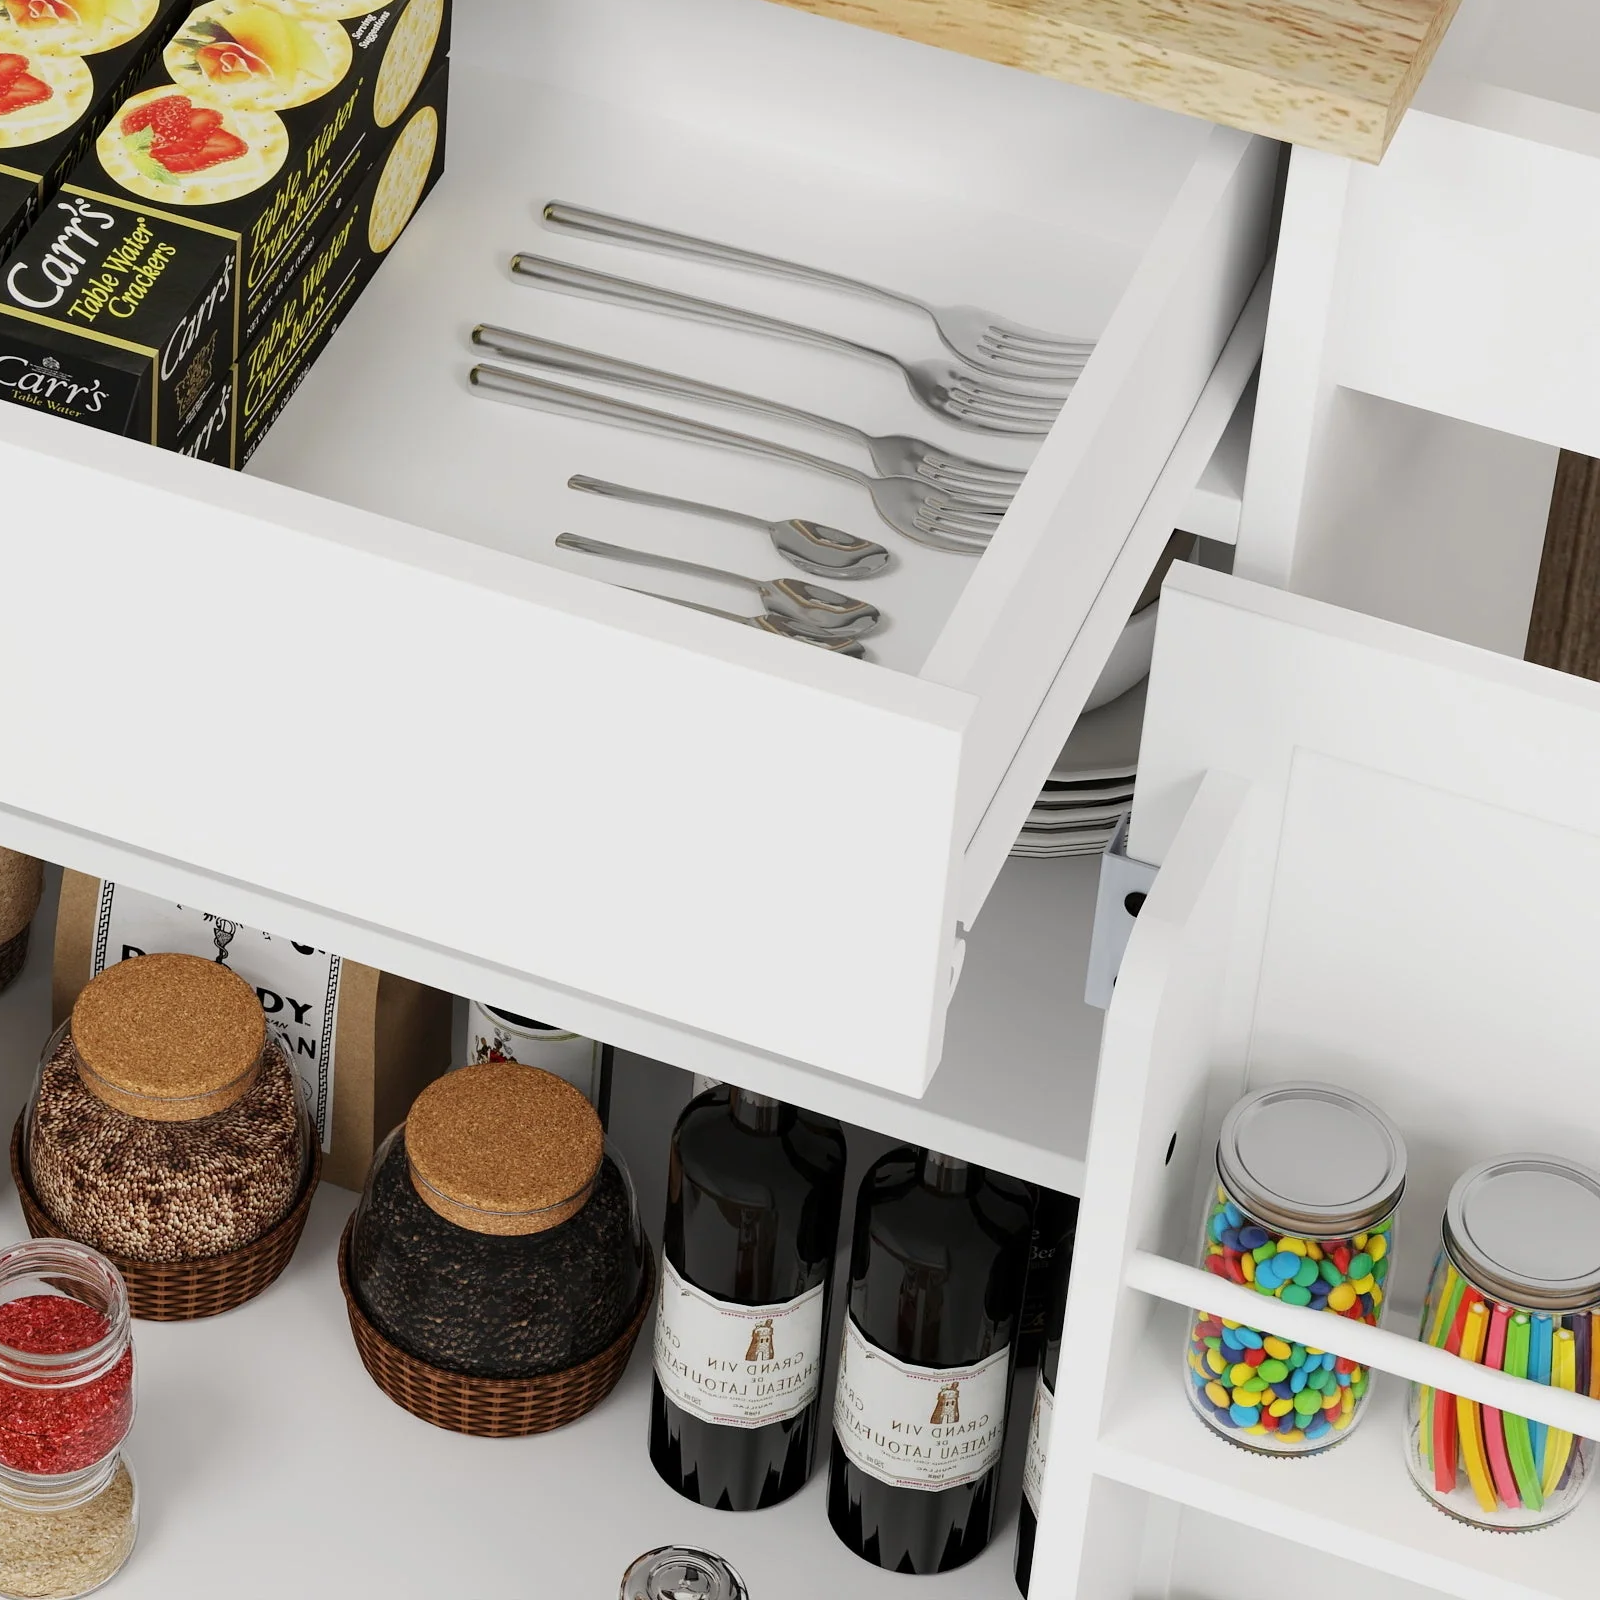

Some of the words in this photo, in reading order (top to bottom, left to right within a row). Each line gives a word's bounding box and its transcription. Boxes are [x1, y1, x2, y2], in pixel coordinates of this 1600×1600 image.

[352, 14, 377, 40] Serving
[359, 11, 390, 49] Suggestions
[247, 159, 330, 288] Crackers
[250, 169, 302, 258] Table
[6, 198, 115, 309] Carr's
[108, 242, 177, 319] Crackers
[67, 273, 118, 323] Table
[160, 254, 235, 381] Carr's
[246, 314, 261, 338] NET
[244, 286, 327, 417] Crackers
[247, 299, 297, 386] Table
[11, 389, 43, 407] Table
[243, 439, 257, 464] NET
